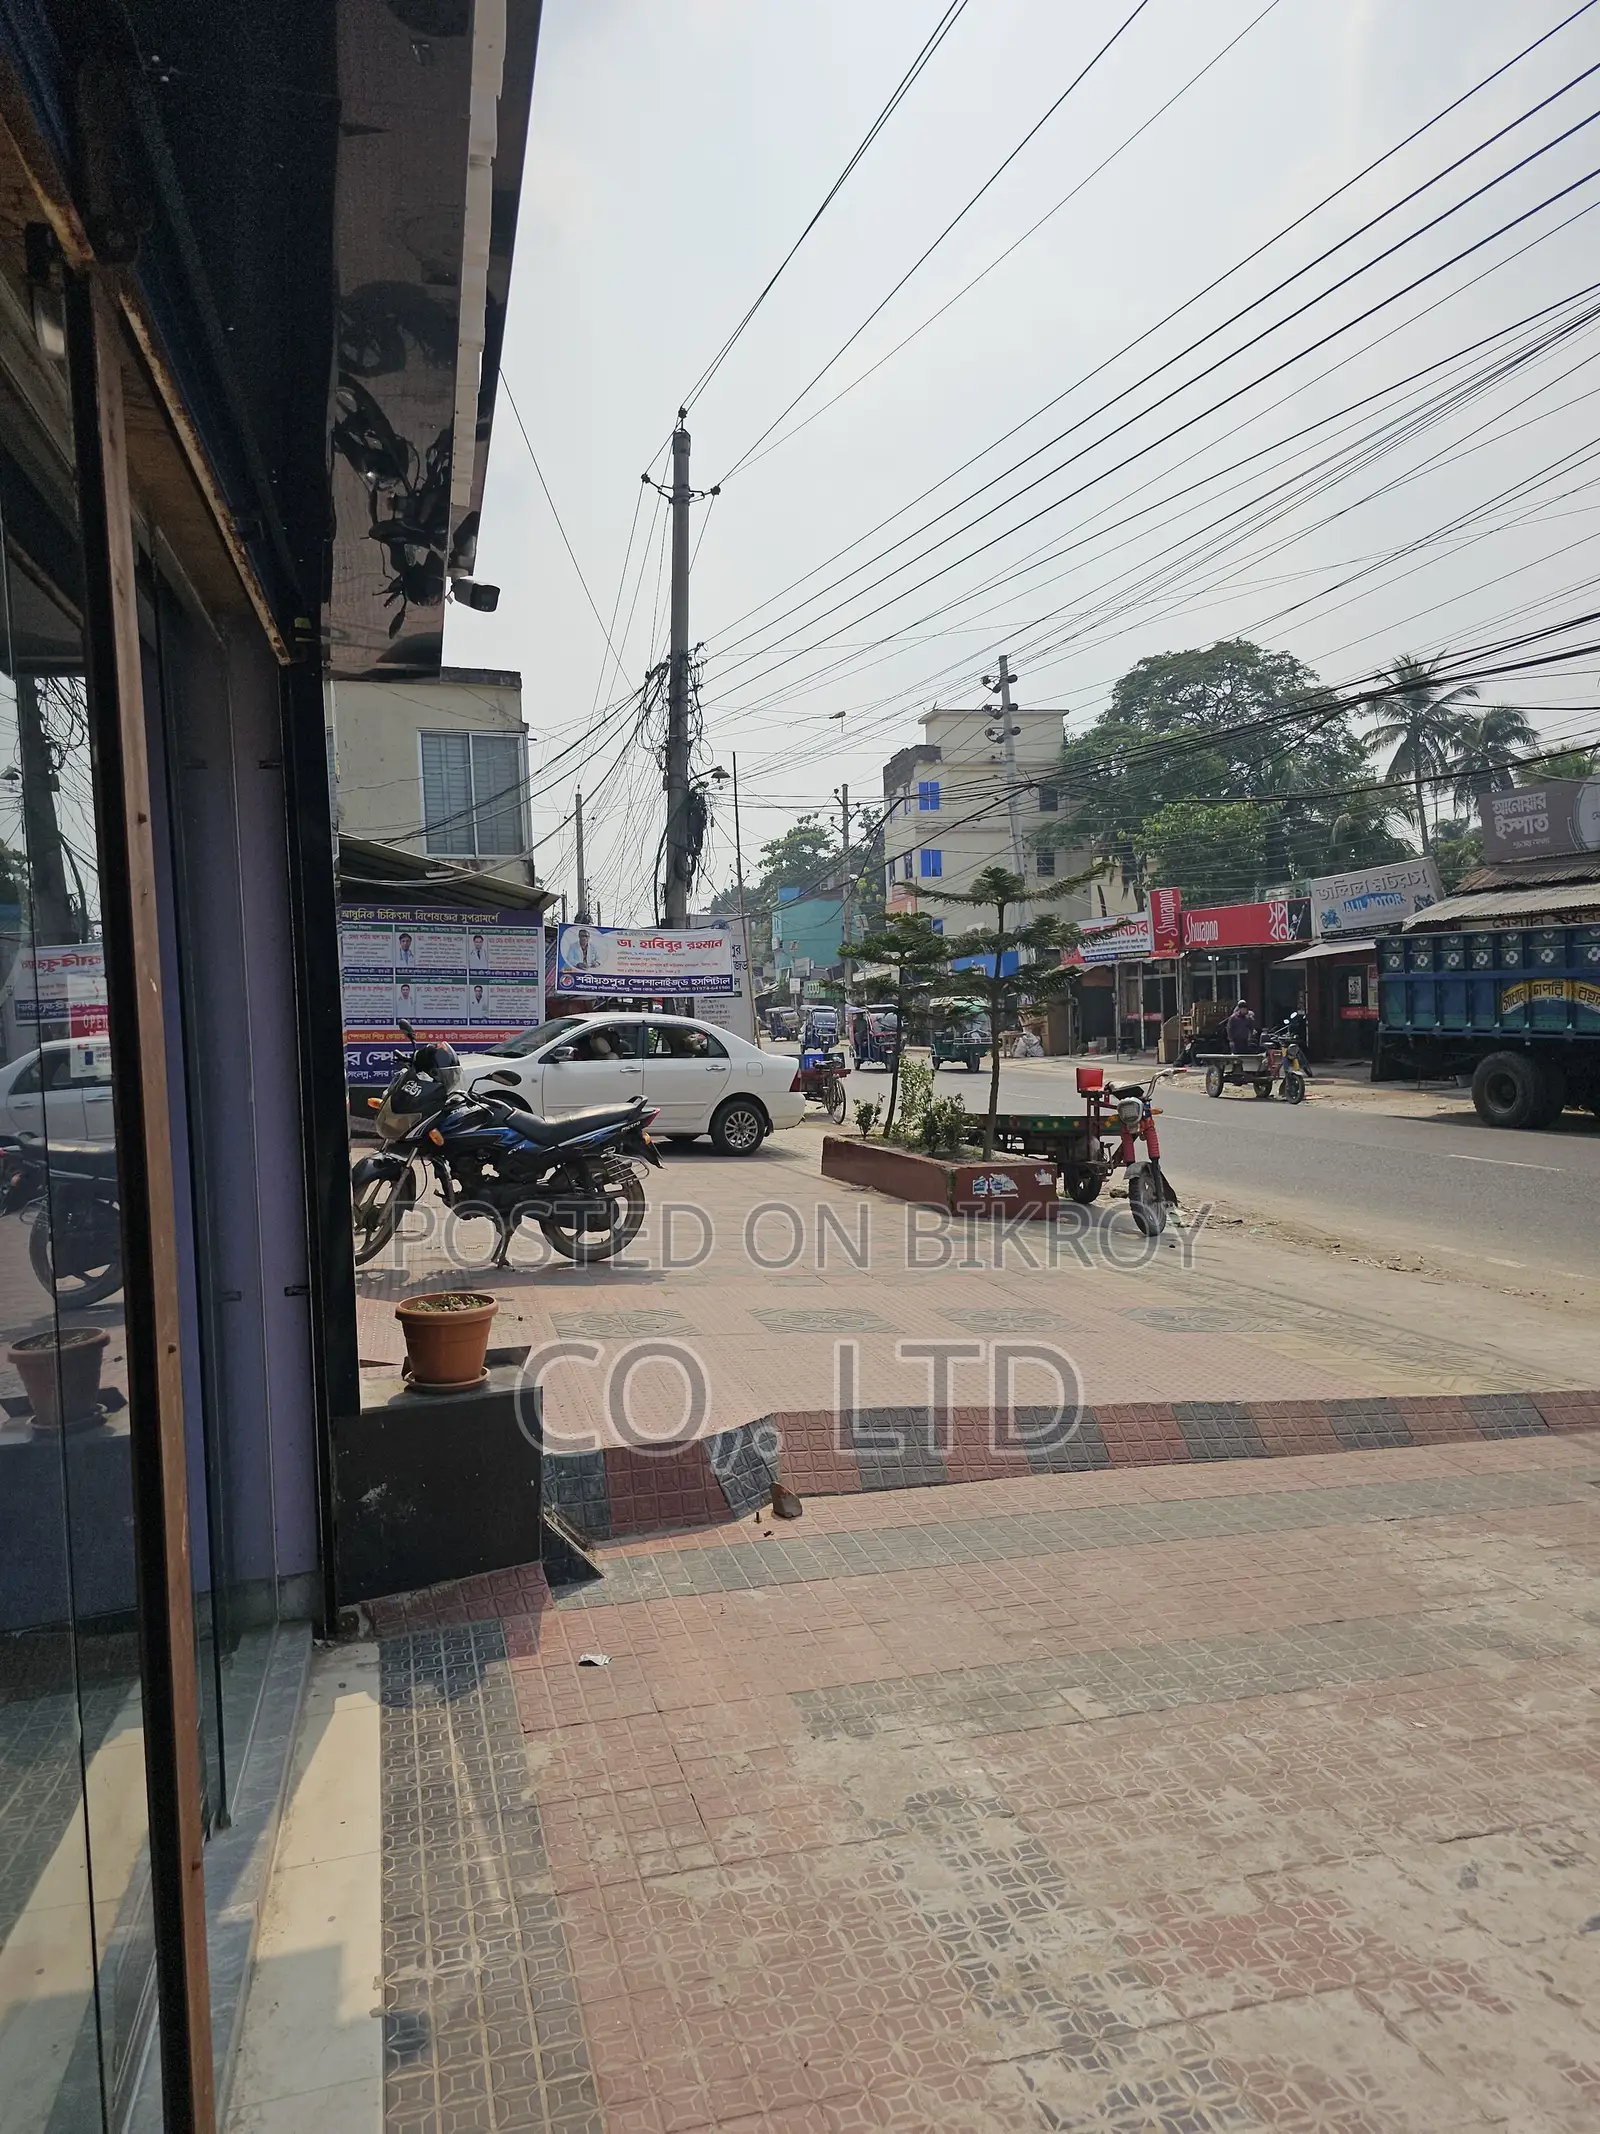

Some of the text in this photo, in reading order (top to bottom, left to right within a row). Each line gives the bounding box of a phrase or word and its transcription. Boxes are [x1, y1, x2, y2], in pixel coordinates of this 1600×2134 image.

[1494, 812, 1550, 840] ইস্পাত
[1155, 889, 1179, 937] Shwapno
[1184, 913, 1219, 945] Shwapno
[640, 937, 682, 953] হাবিবুর
[686, 938, 723, 950] রহমান
[691, 974, 731, 986] হসপিটাল
